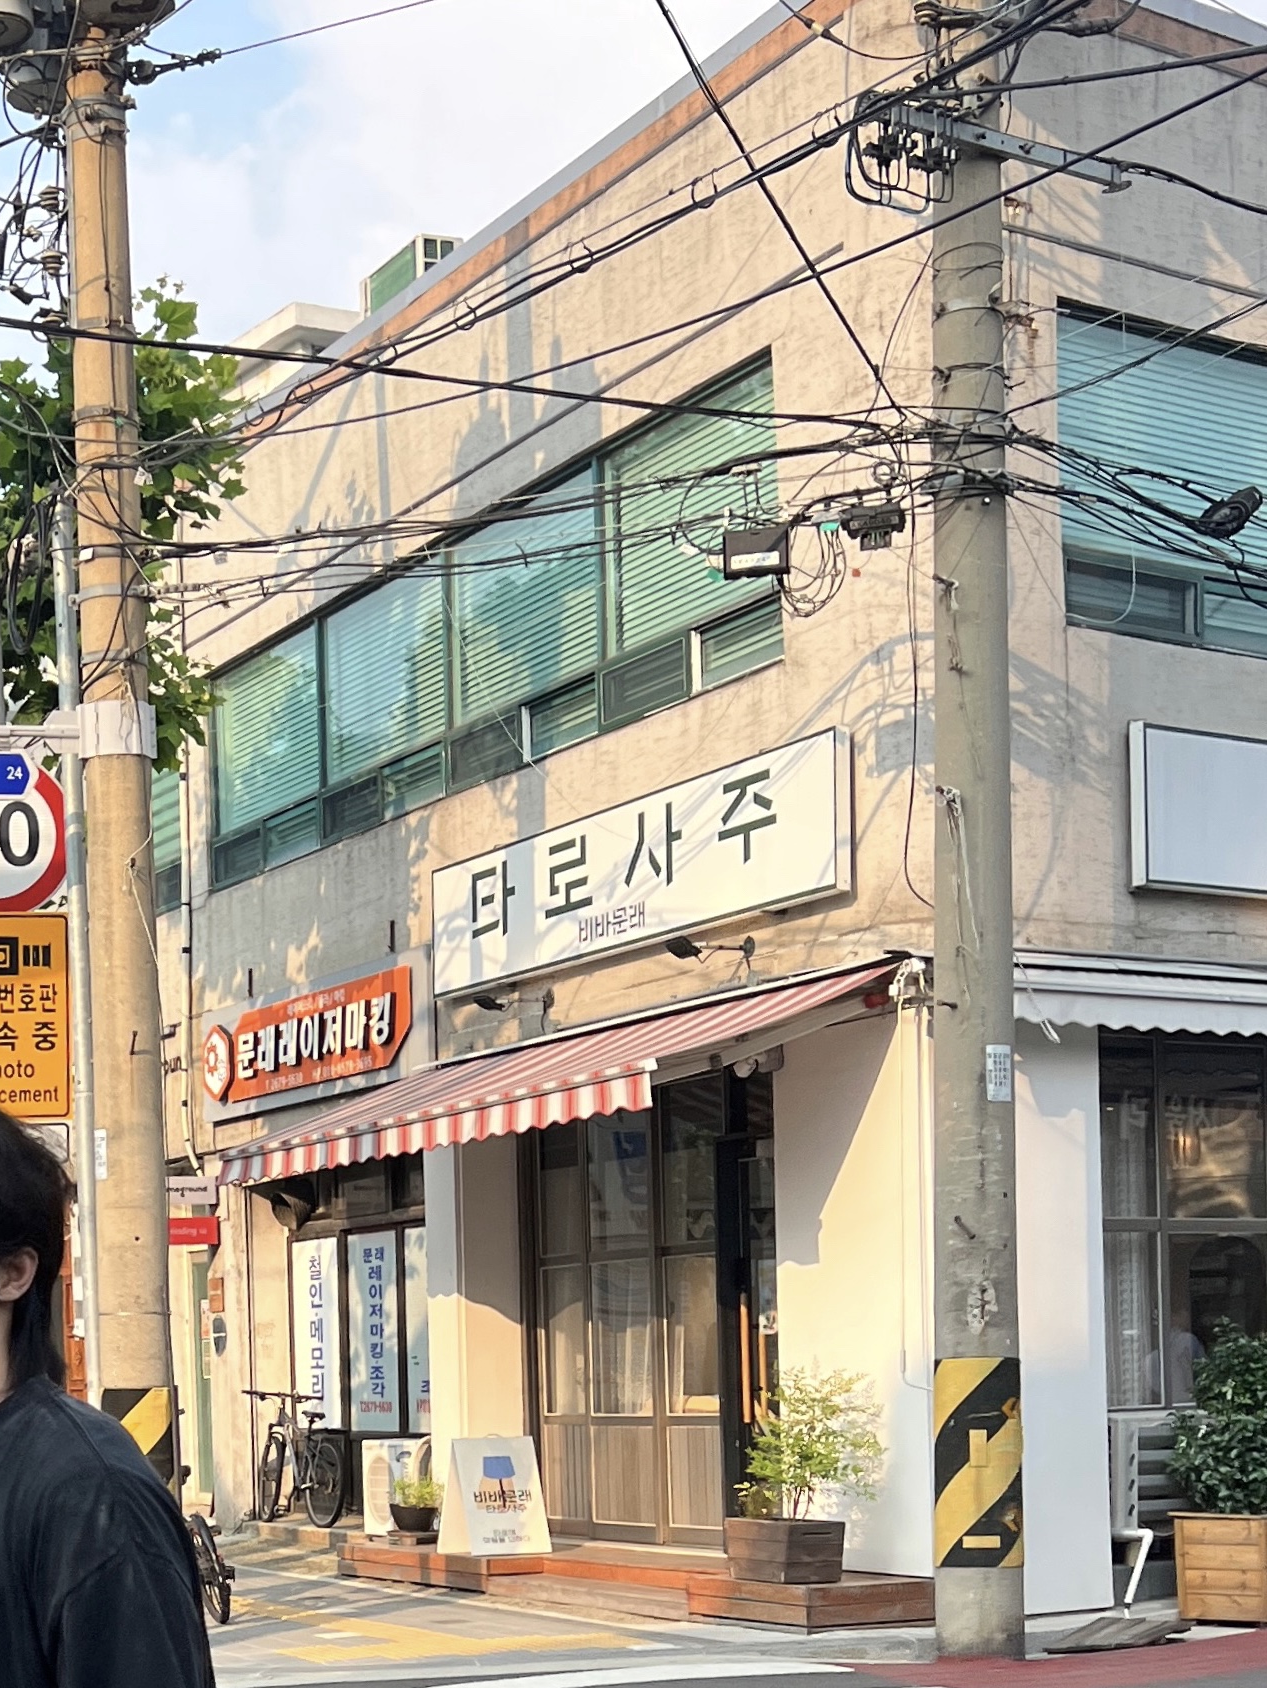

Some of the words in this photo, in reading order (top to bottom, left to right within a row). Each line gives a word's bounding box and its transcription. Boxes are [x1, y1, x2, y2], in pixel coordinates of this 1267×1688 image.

[7, 766, 23, 780] 24
[579, 901, 645, 942] 비바문래
[237, 992, 392, 1080] 문래레이저마킹
[363, 1246, 385, 1263] 문래
